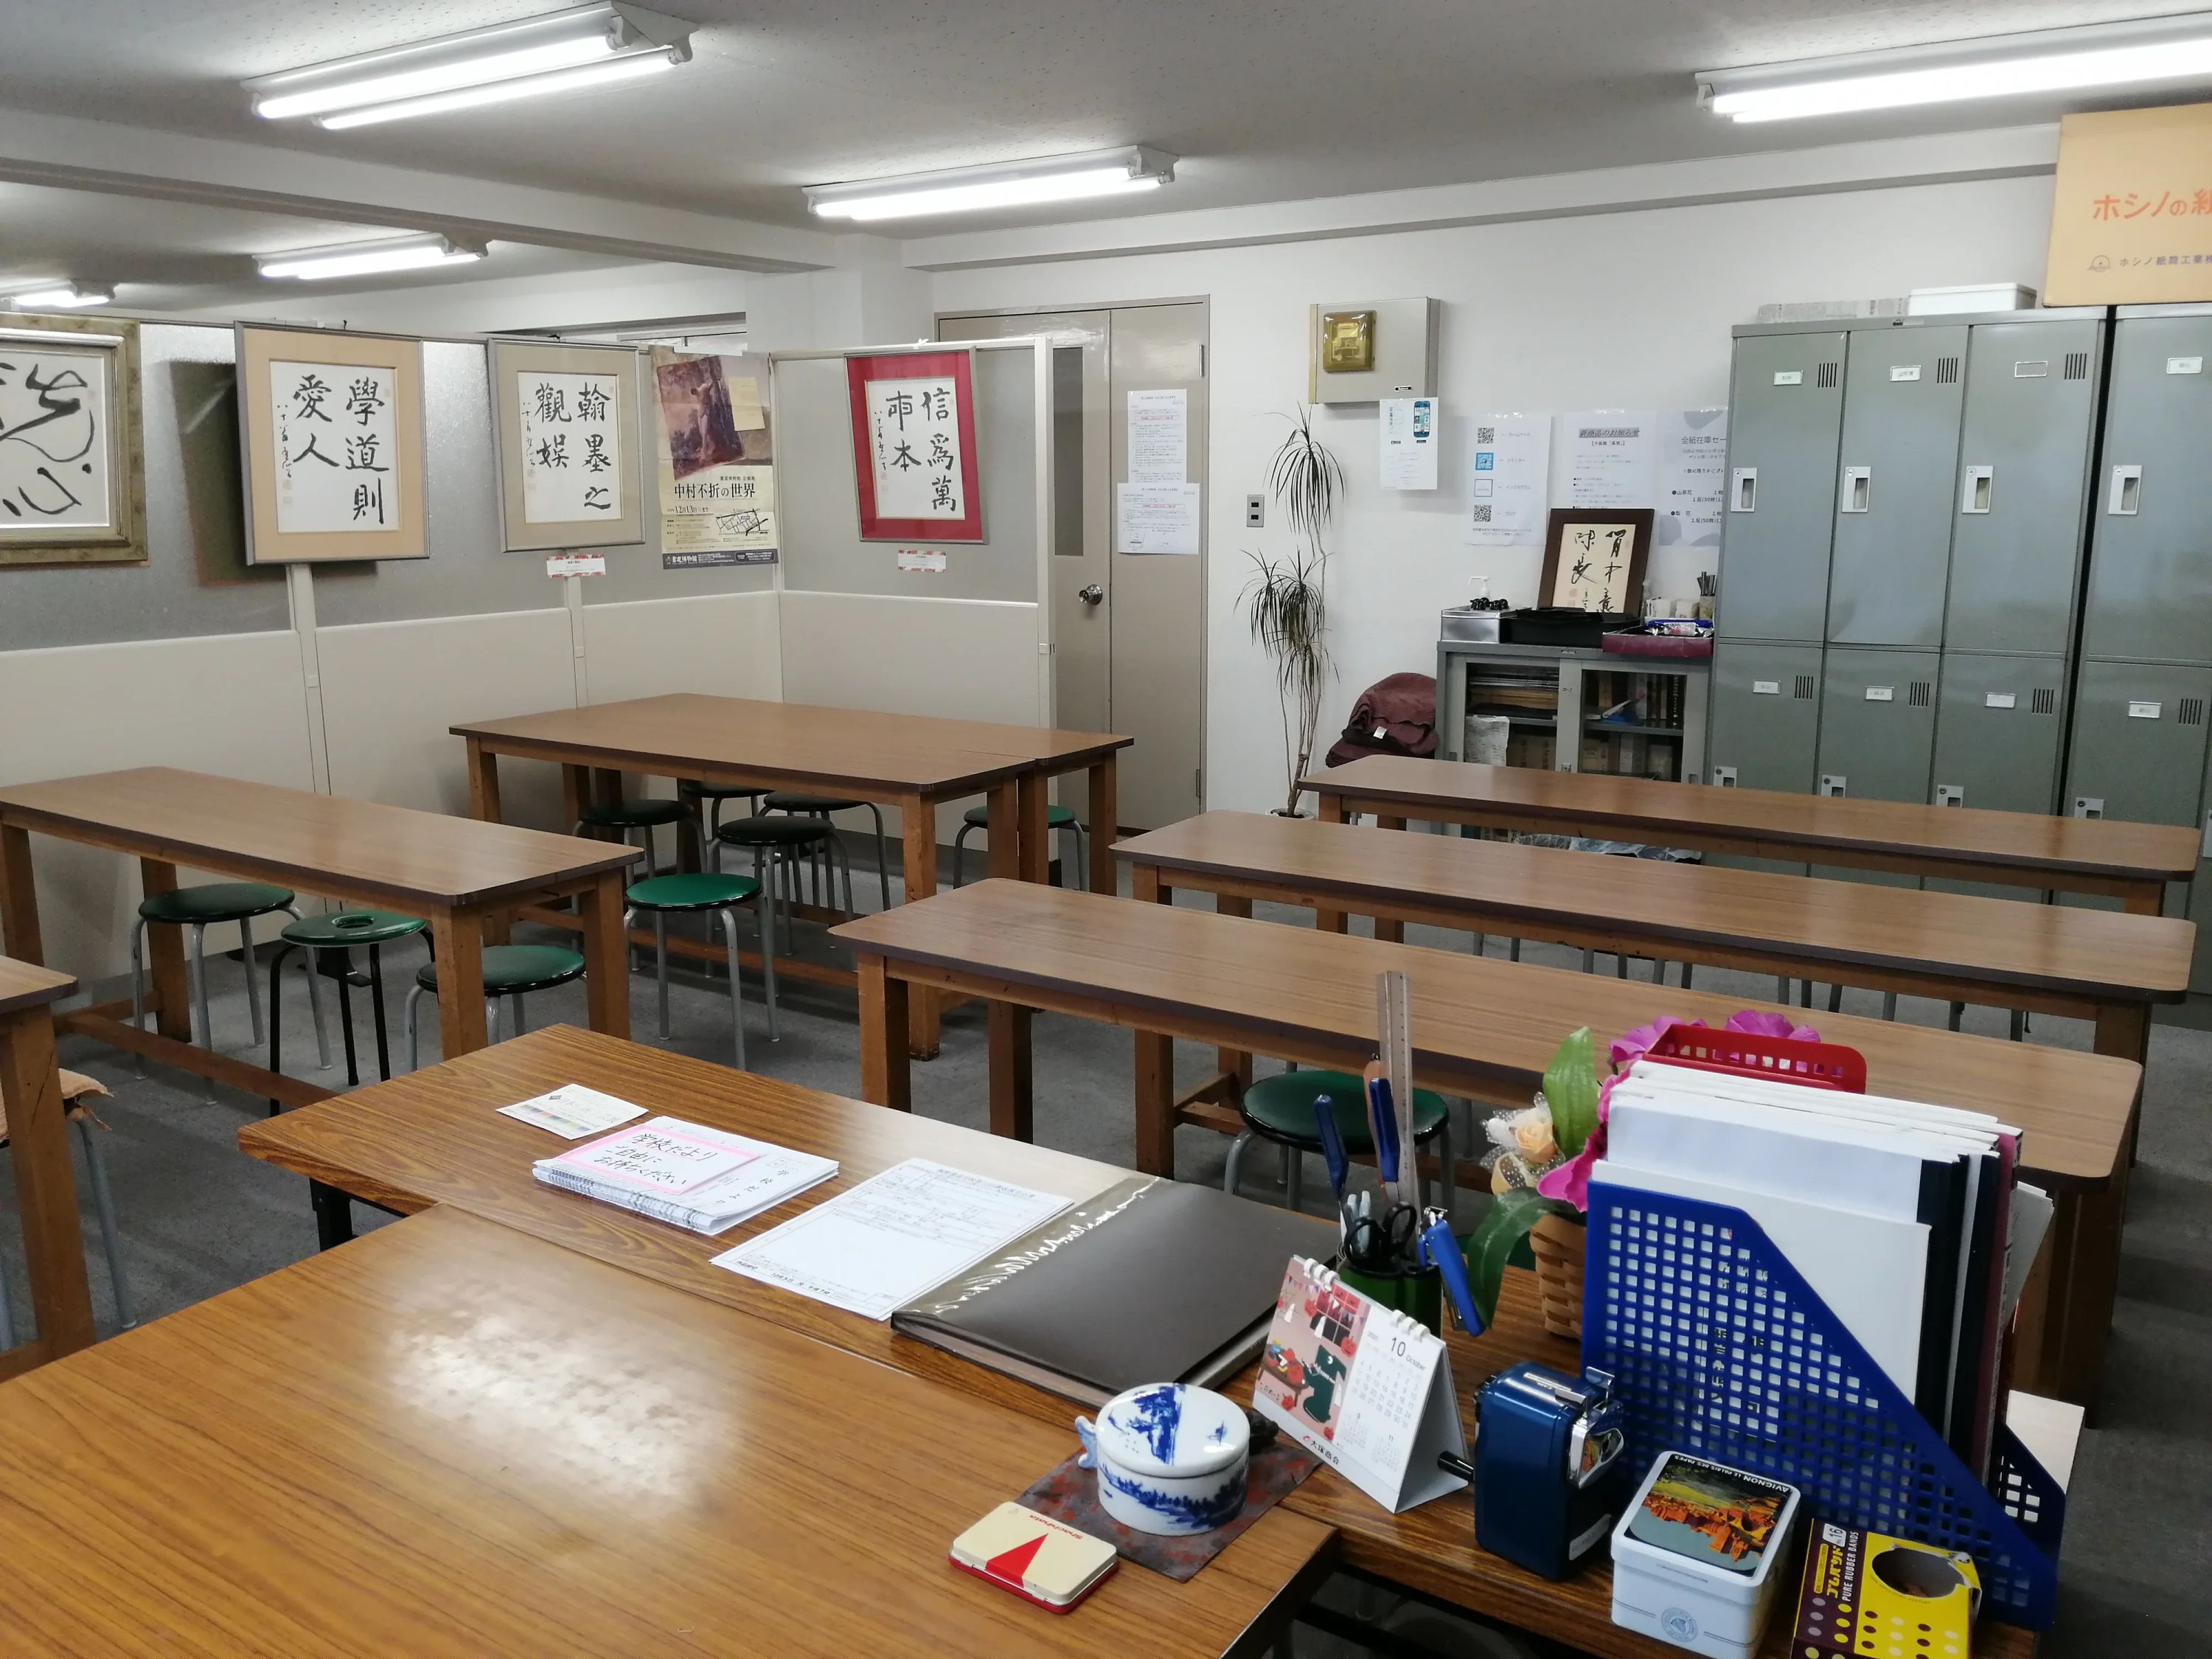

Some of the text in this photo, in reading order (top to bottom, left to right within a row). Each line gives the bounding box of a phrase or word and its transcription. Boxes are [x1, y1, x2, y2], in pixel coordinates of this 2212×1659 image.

[293, 374, 340, 467] 愛人
[675, 483, 756, 498] 中村不折の世界
[606, 1146, 662, 1164] ご自由に
[632, 1133, 718, 1161] 学校だより
[594, 1156, 687, 1185] お持ちください
[1391, 1337, 1407, 1357] 10
[1405, 1354, 1427, 1371] October
[1310, 1440, 1340, 1465] 大塚商会
[1674, 1455, 1696, 1465] PAPES
[1711, 1466, 1733, 1475] PALAIS
[1743, 1475, 1790, 1493] AVIGNON
[1029, 1514, 1083, 1540] Shachihata
[1842, 1531, 1859, 1602] PURE RUBBER BANDS
